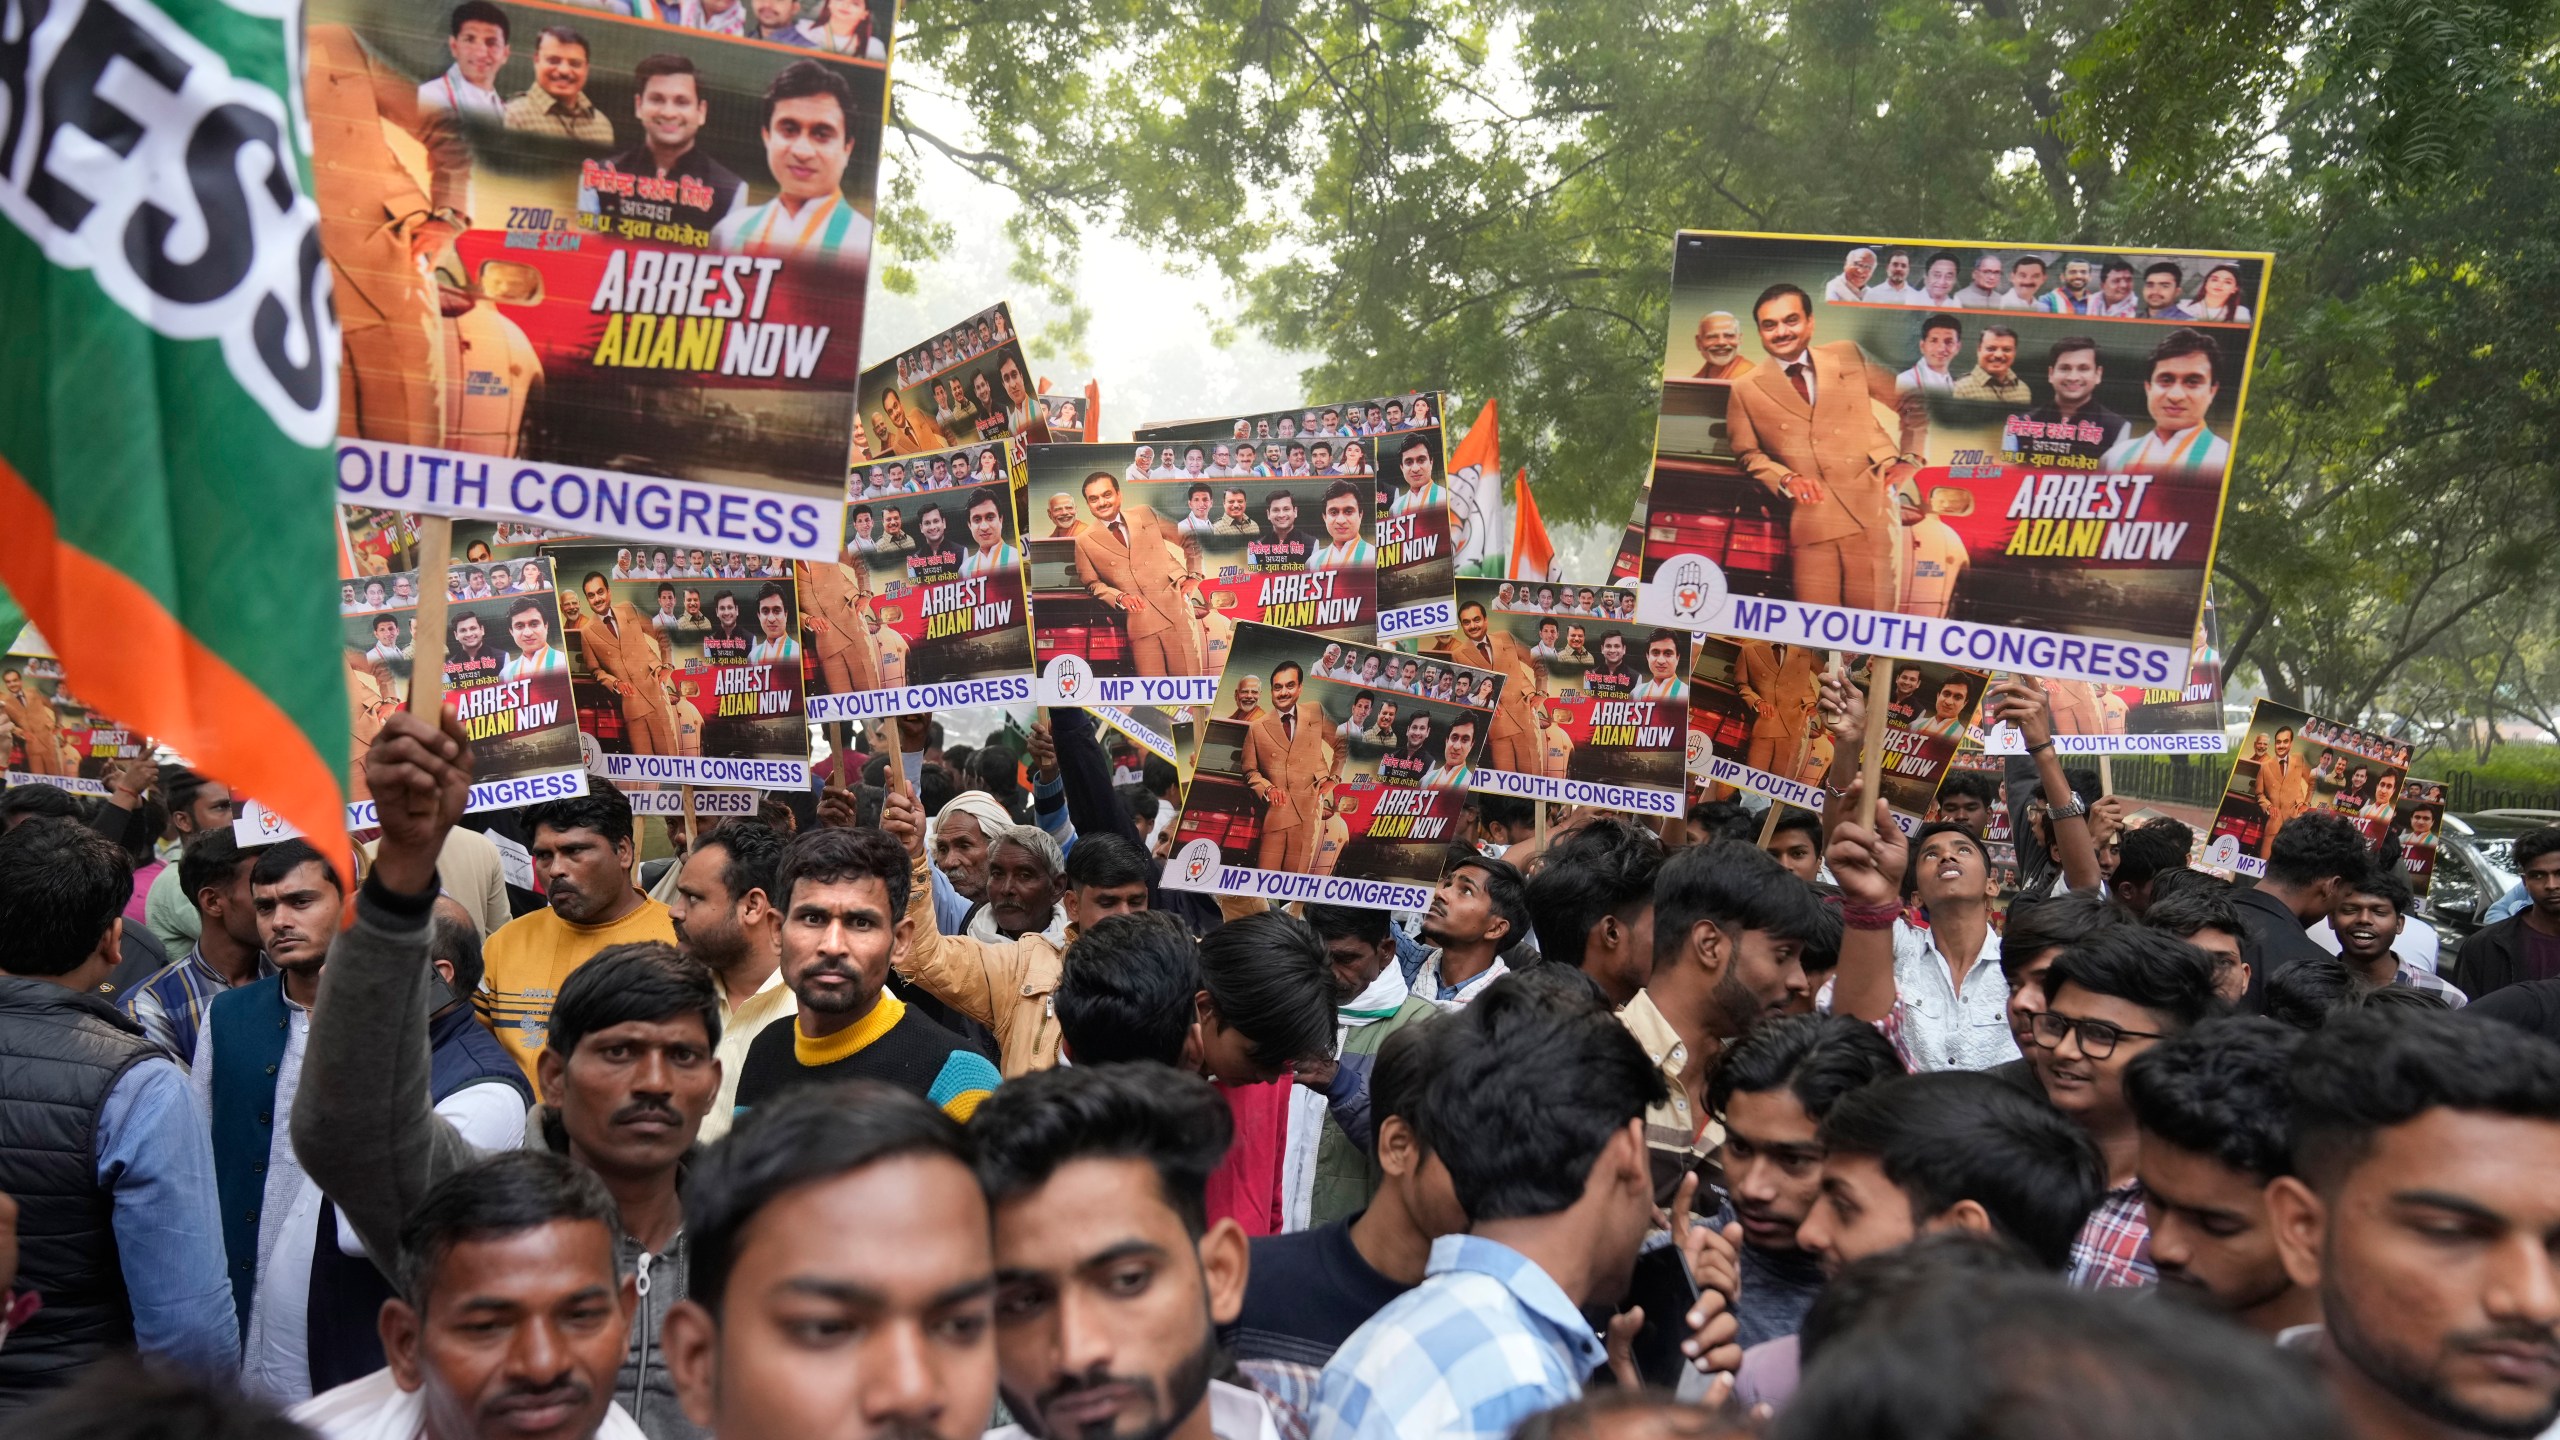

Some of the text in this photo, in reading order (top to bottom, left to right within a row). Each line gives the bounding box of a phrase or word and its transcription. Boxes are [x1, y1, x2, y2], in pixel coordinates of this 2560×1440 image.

[506, 206, 553, 230] 2200
[589, 248, 782, 320] ARREST
[593, 312, 830, 379] ADANI NOW
[1951, 450, 1983, 465] 2200
[510, 467, 821, 550] CONGRESS
[2006, 474, 2153, 520] ARREST
[1376, 513, 1417, 548] REST
[2005, 519, 2189, 560] ADANI NOW
[1376, 533, 1438, 569] ANI NOW
[1219, 565, 1238, 577] 2200
[885, 580, 900, 592] 2200
[921, 575, 987, 618] ARREST
[1258, 570, 1338, 606] ARREST
[926, 607, 972, 640] ADANI
[974, 598, 1012, 631] NOW
[1263, 596, 1362, 628] ADANI NOW
[1377, 604, 1449, 633] GRESS
[1733, 599, 2170, 683] MP YOUTH CONGRESS
[714, 664, 772, 696] ARREST
[1100, 679, 1218, 701] MP YOUTH
[1560, 688, 1576, 697] 2200
[457, 678, 531, 721] ARREST
[718, 689, 792, 717] ADANI NOW
[806, 677, 1029, 719] MP YOUTH CONGRESS
[2143, 683, 2212, 706] ADANI NOW
[466, 699, 558, 741] ADANI NOW
[1093, 706, 1120, 722] UTH
[1589, 701, 1656, 726] ARREST
[90, 730, 129, 746] ARREST
[1591, 725, 1675, 747] ADANI NOW
[2060, 737, 2119, 751] YOUTH
[2125, 736, 2222, 750] CONGRESS
[91, 744, 141, 758] ADANI NOW
[12, 774, 30, 785] MP
[607, 755, 803, 783] MP YOUTH CONGRESS
[1896, 755, 1938, 778] NOW
[1469, 768, 1676, 813] MP YOUTH CONGRESS
[1710, 759, 1740, 783] MP
[1744, 768, 1807, 804] YOUTH
[656, 792, 752, 812] COGRESS
[1371, 789, 1439, 816] ARREST
[1367, 815, 1448, 839] ADANI NOW
[1988, 827, 2011, 840] NOW
[2237, 856, 2256, 872] MP
[1219, 867, 1427, 909] MP YOUTH CONGRESS
